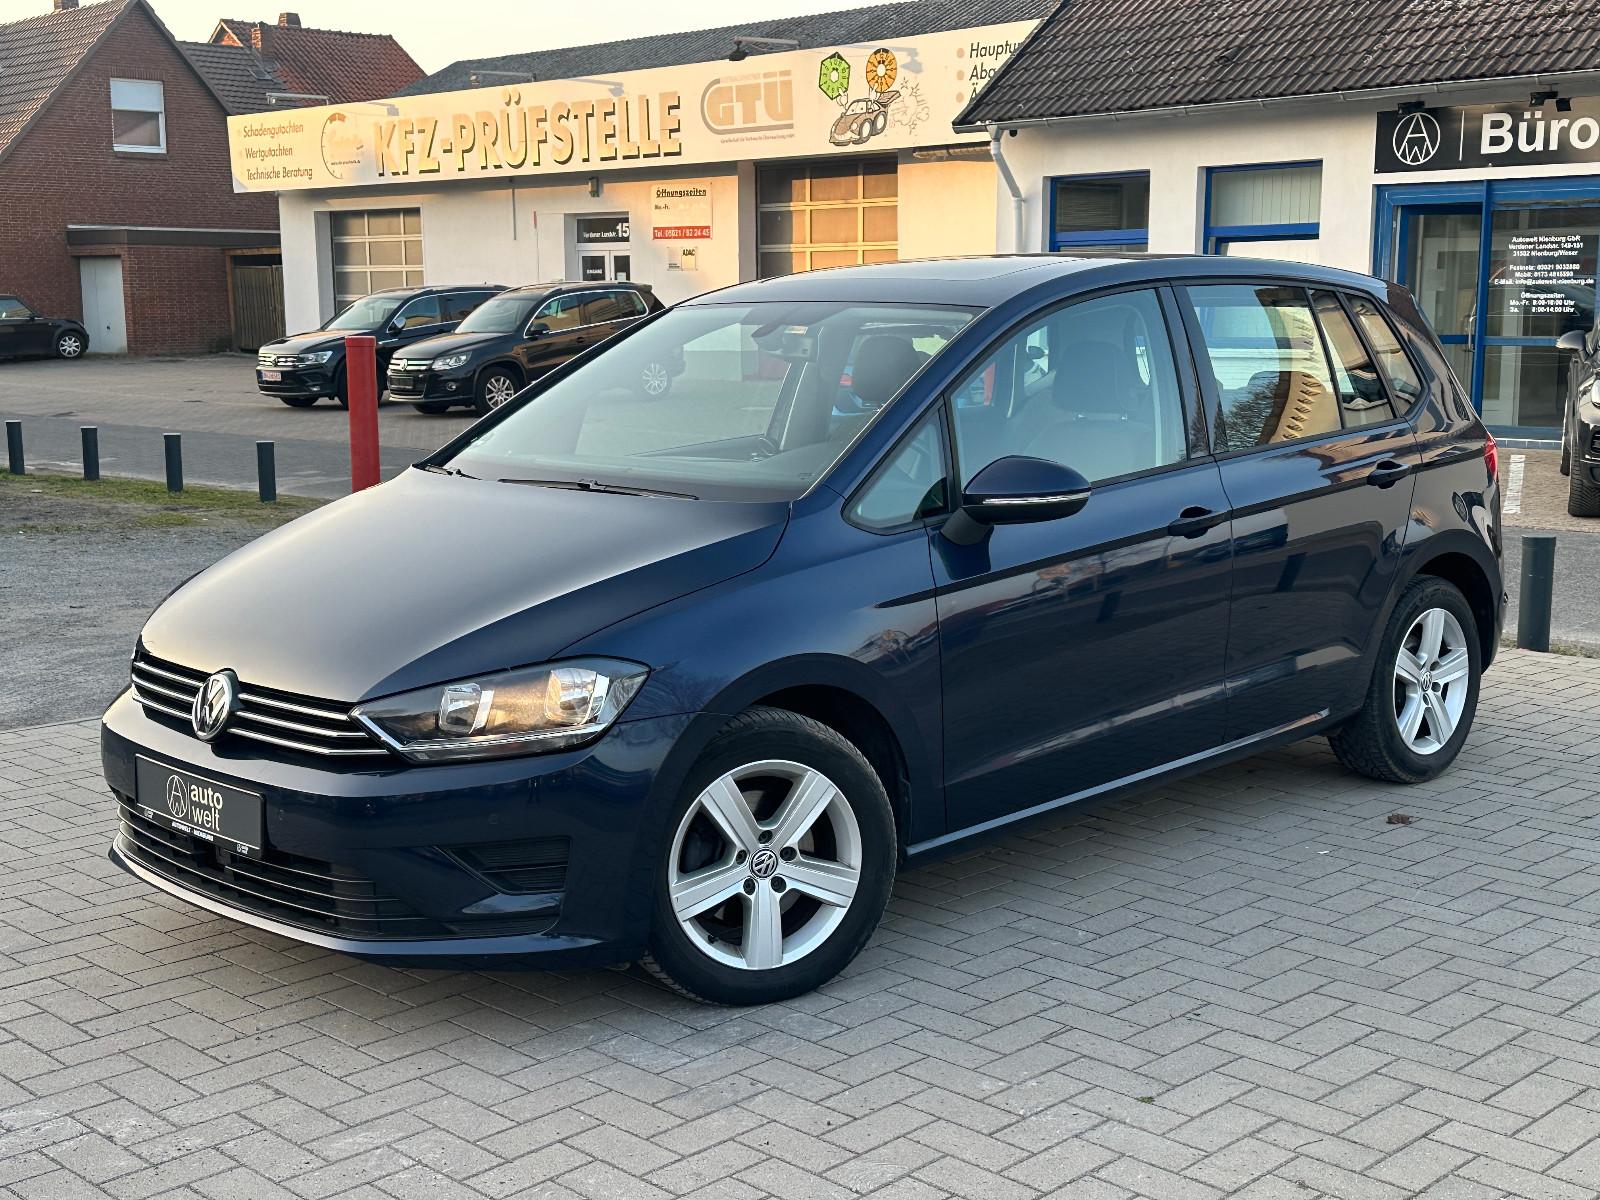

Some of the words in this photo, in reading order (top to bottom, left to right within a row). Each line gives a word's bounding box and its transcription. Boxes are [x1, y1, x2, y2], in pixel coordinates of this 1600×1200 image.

[243, 121, 304, 138] Schadengutachten
[373, 87, 683, 177] KFZ-PRÜFSTELLE
[1480, 110, 1600, 154] Büro
[245, 144, 293, 161] Wertgutachten
[247, 165, 281, 180] Technische
[282, 166, 313, 180] Beratung
[656, 187, 707, 198] Öffnungszeiten
[654, 229, 665, 238] Tel.
[190, 784, 223, 810] auto
[191, 805, 220, 831] welt
